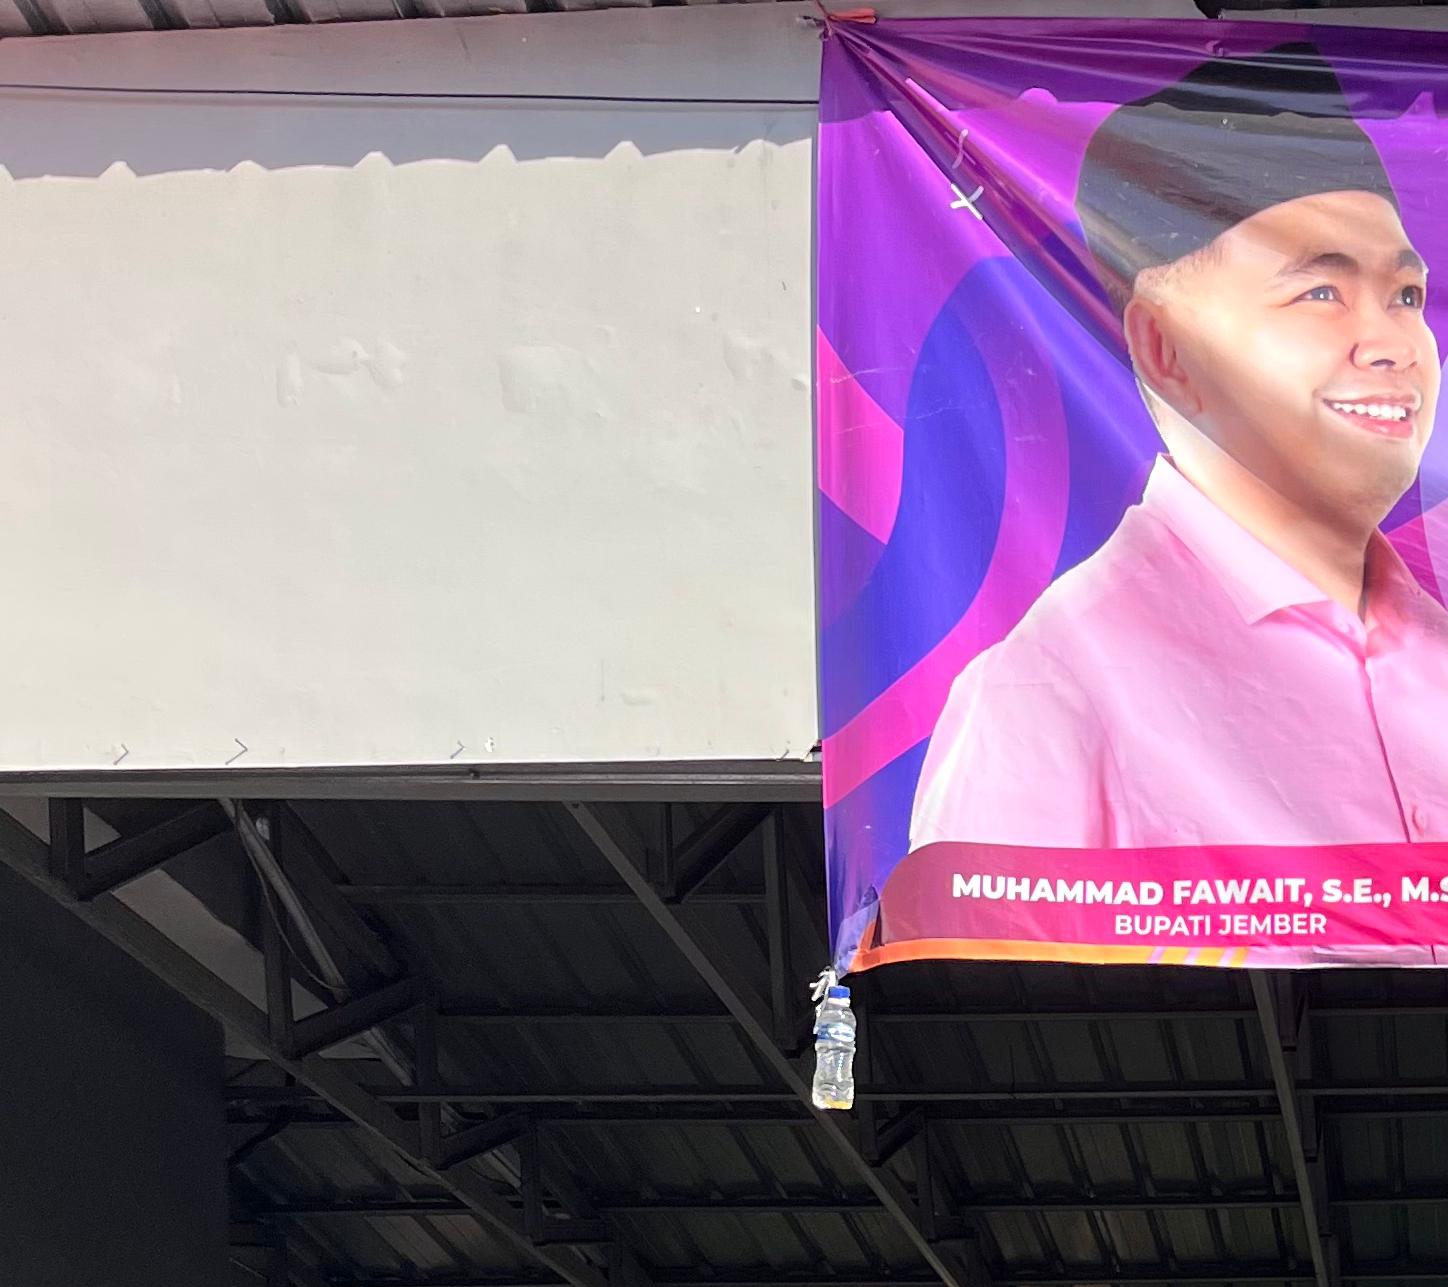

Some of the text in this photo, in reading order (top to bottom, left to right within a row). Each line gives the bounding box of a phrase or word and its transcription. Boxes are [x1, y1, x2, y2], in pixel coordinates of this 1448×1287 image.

[952, 873, 1165, 906] MUHAMMAD
[1172, 877, 1313, 908] FAWAIT,
[1322, 877, 1392, 908] S.E.,
[1114, 913, 1328, 937] BUPATI JEMBER
